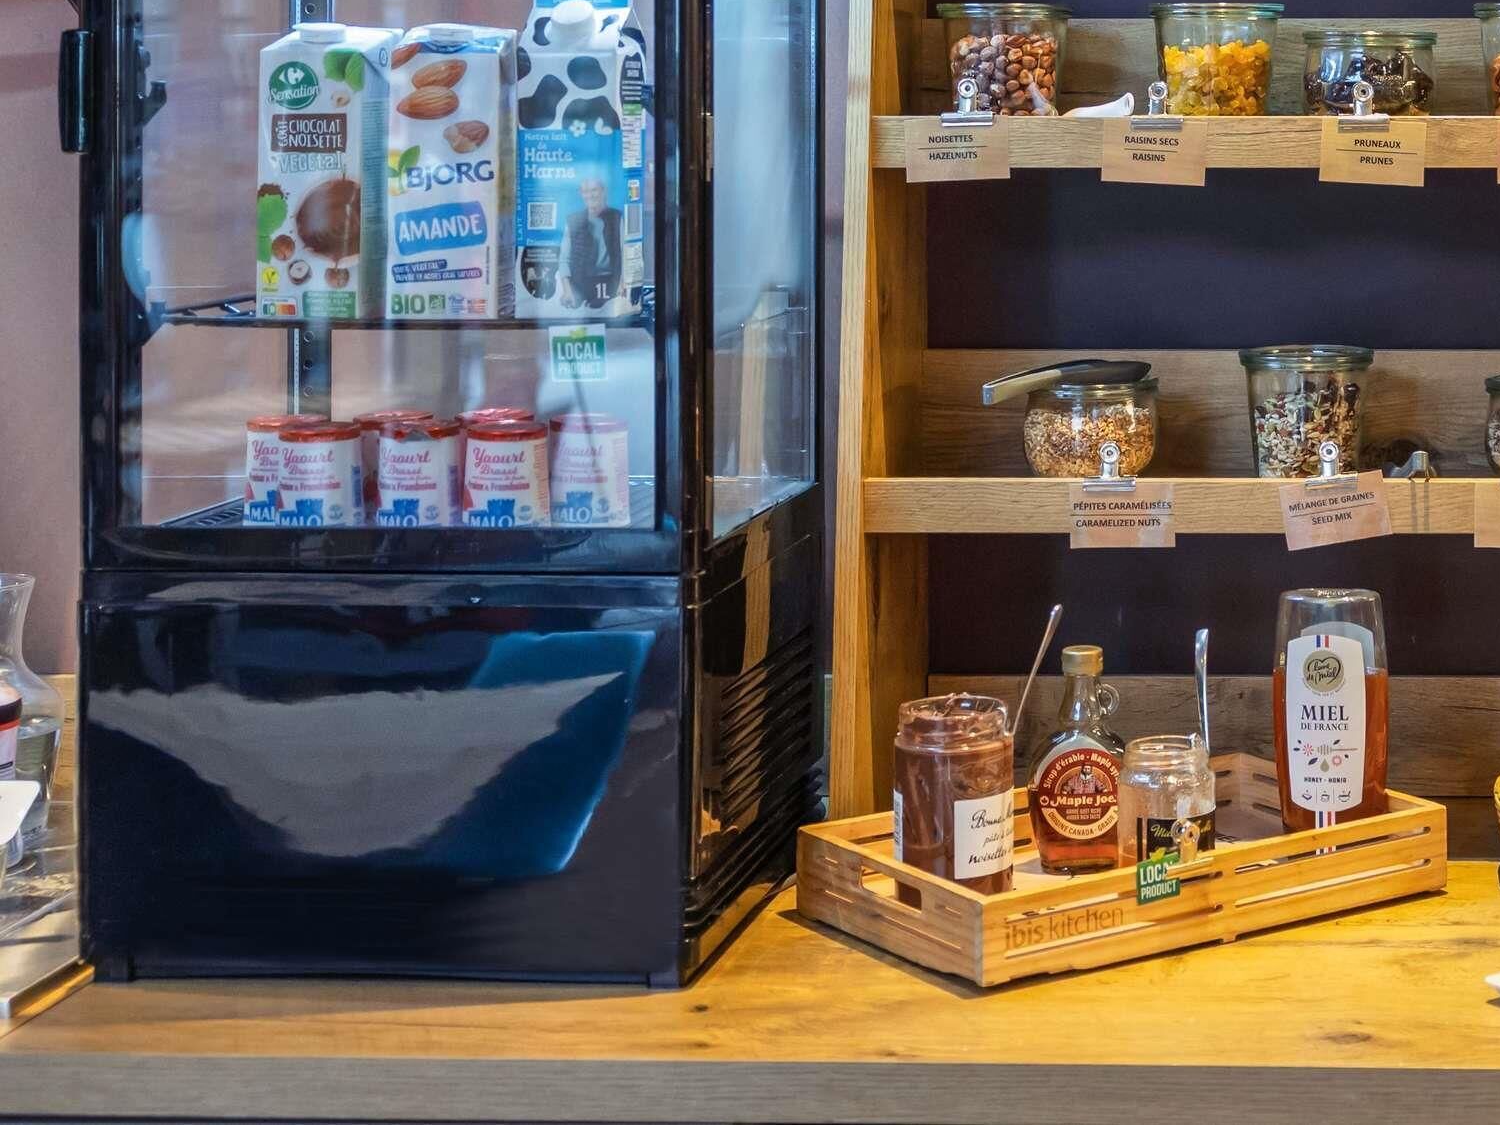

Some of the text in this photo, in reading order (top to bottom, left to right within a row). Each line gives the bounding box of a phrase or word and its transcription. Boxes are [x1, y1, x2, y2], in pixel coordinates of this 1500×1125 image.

[270, 85, 320, 101] Sensation
[289, 119, 342, 134] CHOCOLAT
[288, 134, 344, 149] NOISETTE
[928, 134, 974, 144] NOISETTES
[1124, 135, 1179, 147] RAISINS SECS
[1353, 138, 1401, 149] PRUNEAUX
[524, 147, 574, 162] Haute
[928, 150, 978, 160] HAZELNUTS
[1132, 152, 1166, 162] RAISINS
[1360, 155, 1394, 166] PRUNES
[399, 214, 483, 242] AMANDE
[392, 294, 425, 314] BIO
[557, 342, 600, 360] LOCAL
[473, 447, 526, 469] Yaourt
[1073, 498, 1173, 511] PÉPITES CARAMÉLISÉES
[1288, 491, 1375, 513] MÉLANGE DE GRAINES
[1076, 517, 1161, 528] CARAMELIZED NUTS
[1311, 511, 1352, 526] SEED MIX
[1301, 704, 1349, 721] MIEL
[1301, 723, 1349, 731] DE FRANCE
[1043, 769, 1058, 788] Sirop
[1050, 795, 1093, 807] Maple
[1068, 828, 1094, 836] CANADA
[1140, 862, 1170, 886] LOCA
[1140, 879, 1177, 900] PRODUCT
[1004, 906, 1124, 950] ibis kitchen
